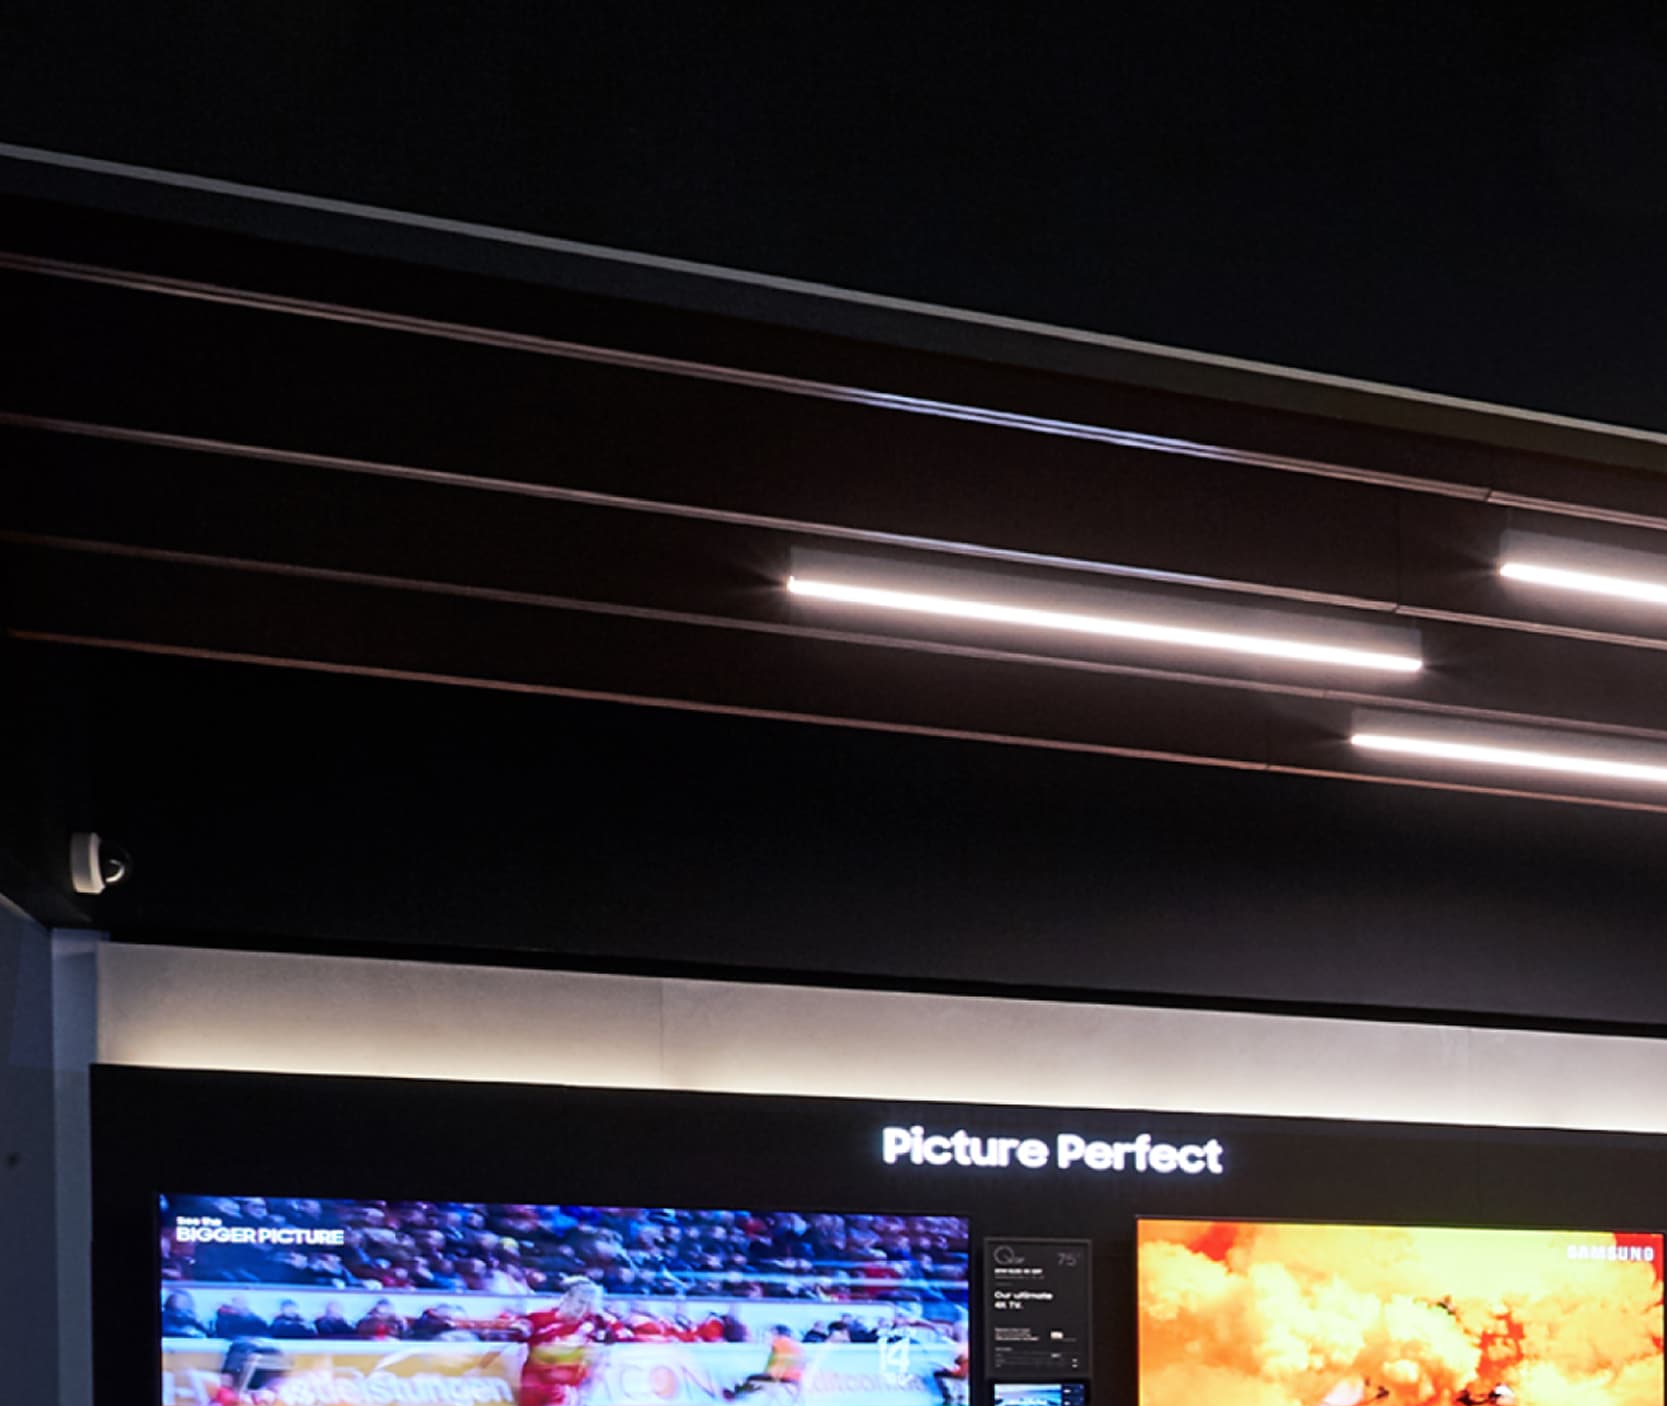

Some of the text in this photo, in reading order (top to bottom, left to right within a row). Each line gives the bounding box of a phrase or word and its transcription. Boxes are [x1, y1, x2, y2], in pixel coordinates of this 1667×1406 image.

[882, 1125, 1223, 1174] Picture Perfect
[176, 1227, 345, 1245] BIGGER PICTURE
[1567, 1244, 1654, 1262] SAMSUNG
